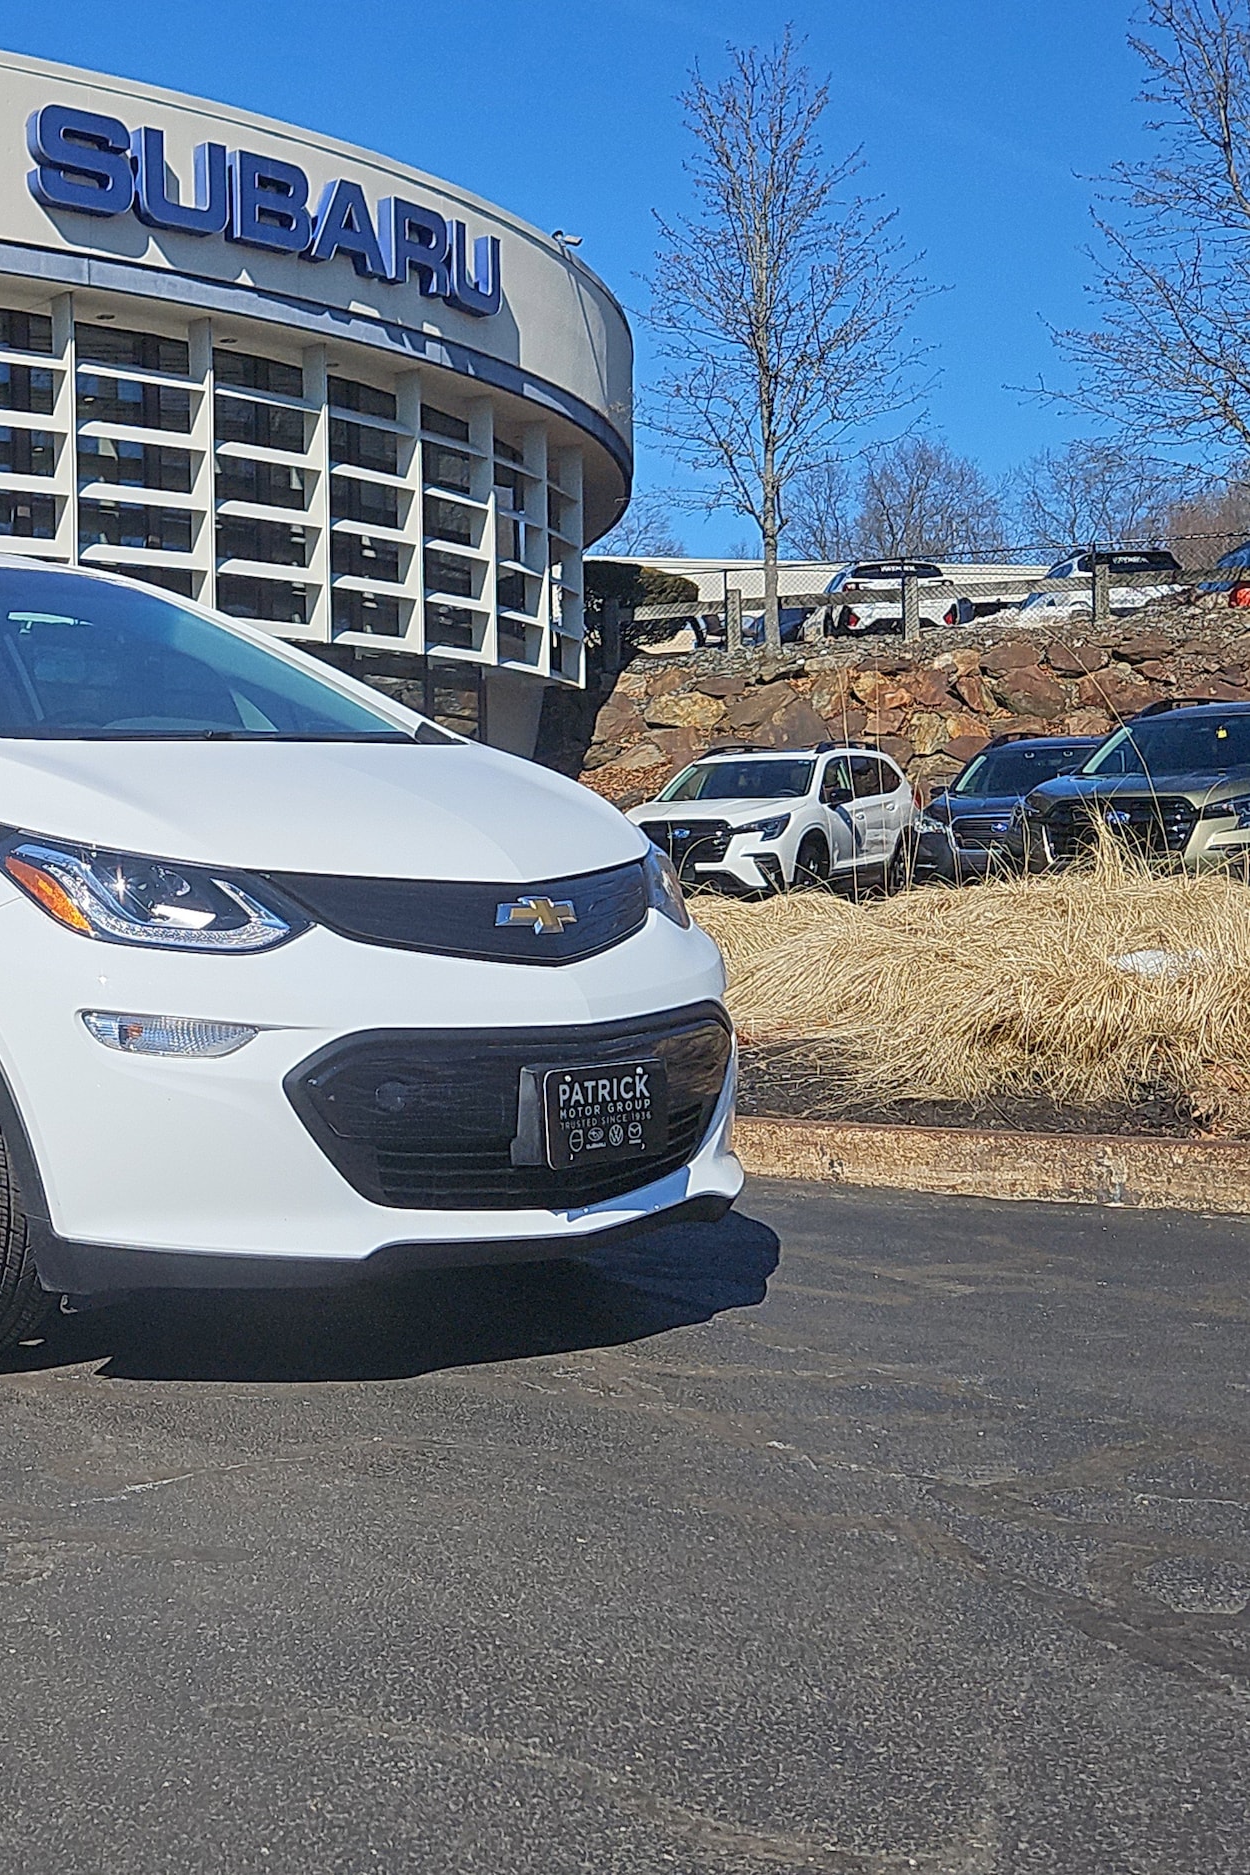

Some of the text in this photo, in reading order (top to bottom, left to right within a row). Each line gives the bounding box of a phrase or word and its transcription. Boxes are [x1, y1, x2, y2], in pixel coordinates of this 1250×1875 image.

[25, 103, 502, 318] SUBARU
[558, 1074, 650, 1107] PATRICK
[559, 1098, 651, 1120] MOTOR GROUP
[559, 1110, 652, 1130] TRUSTED SINCE 1936
